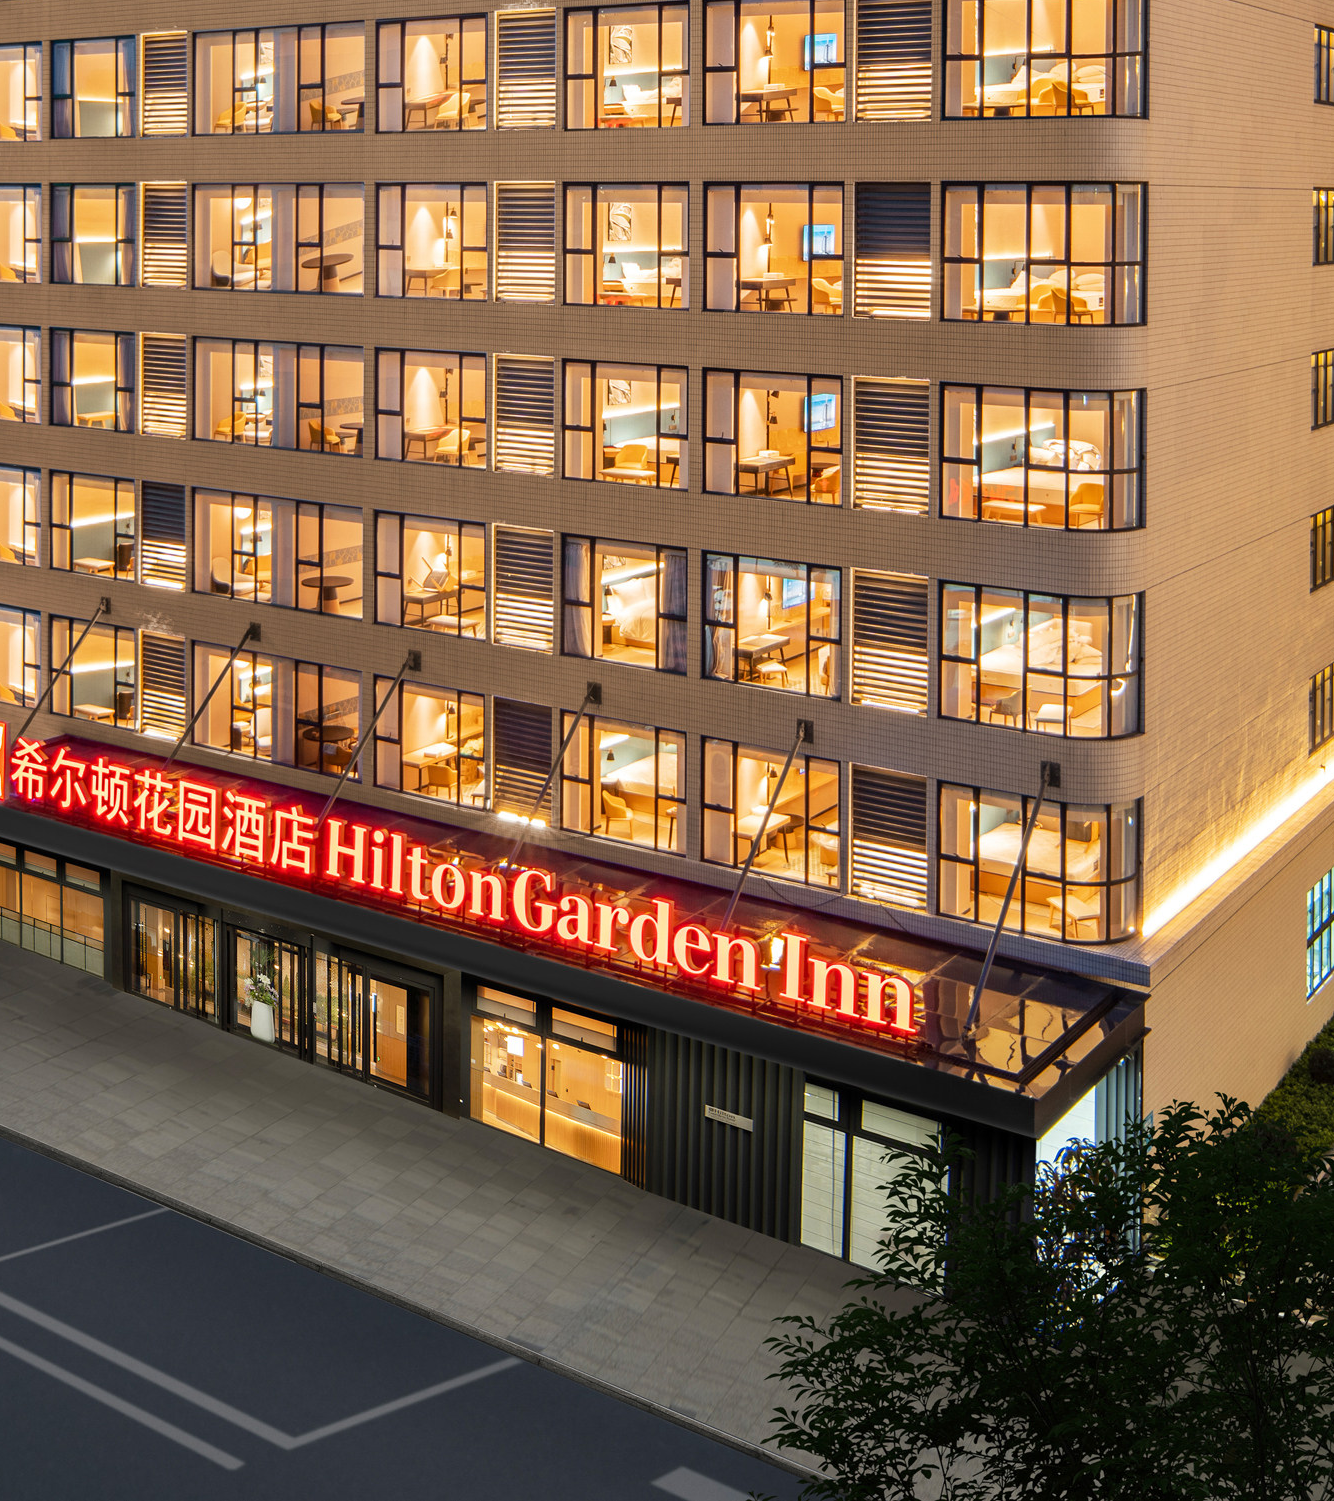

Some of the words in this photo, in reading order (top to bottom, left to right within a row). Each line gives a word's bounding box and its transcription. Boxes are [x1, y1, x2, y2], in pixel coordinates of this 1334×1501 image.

[10, 736, 317, 875] 希尔顿花园酒店
[325, 818, 506, 922] Hilton
[512, 869, 762, 992] Garden
[779, 931, 920, 1035] Inn
